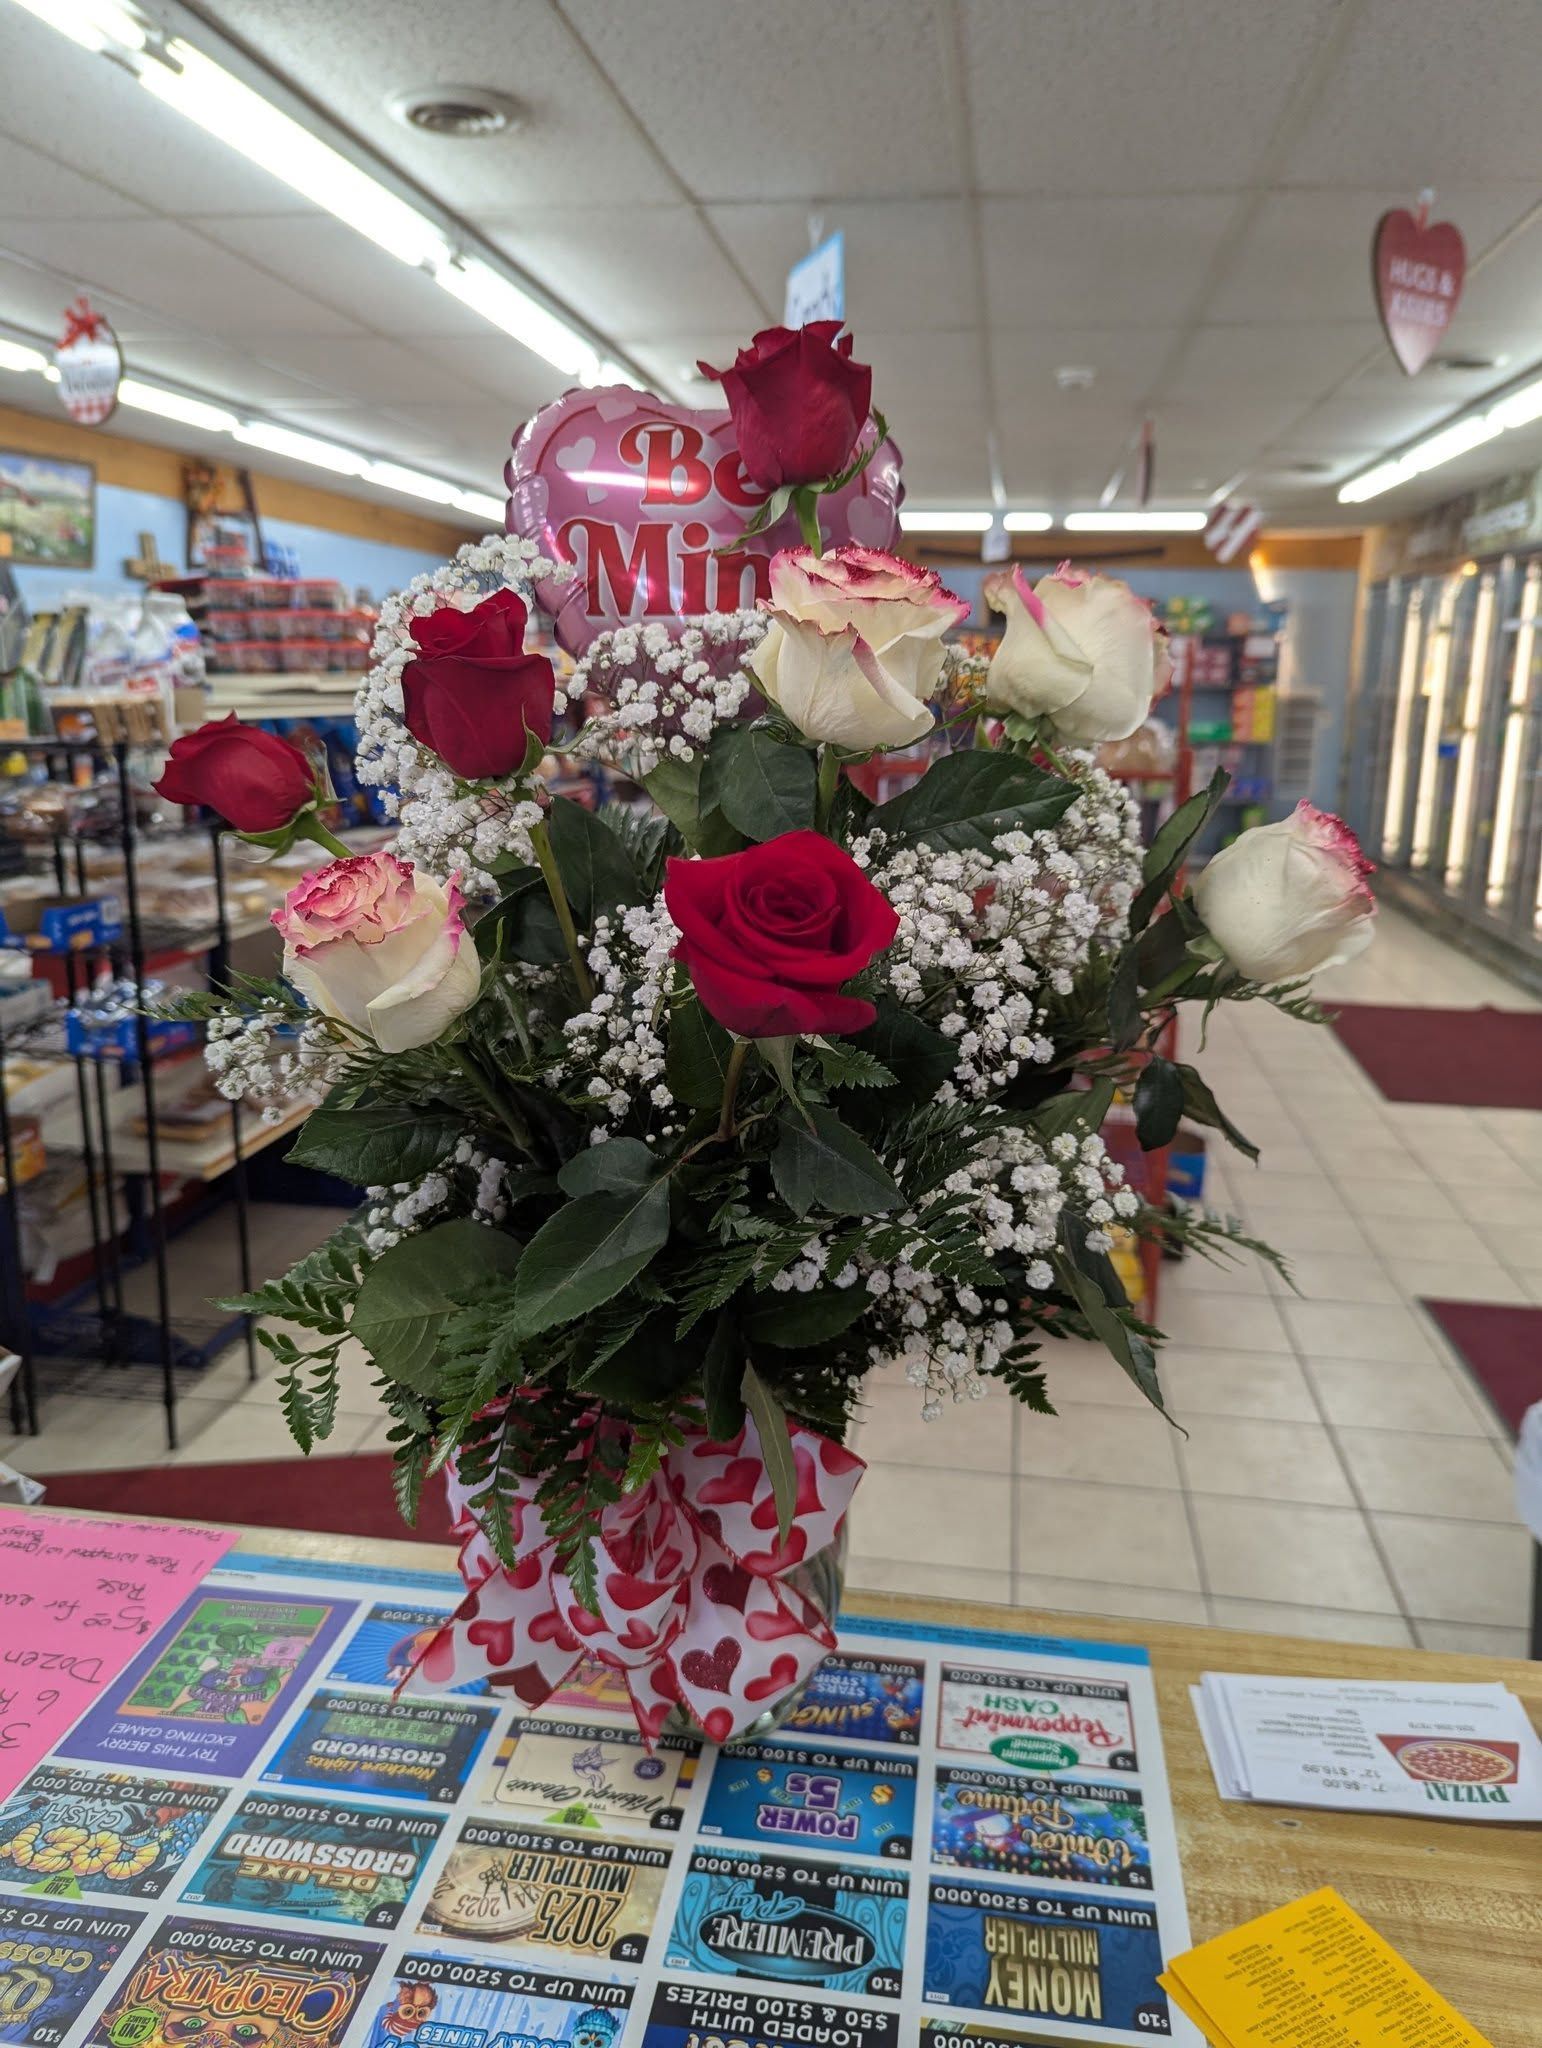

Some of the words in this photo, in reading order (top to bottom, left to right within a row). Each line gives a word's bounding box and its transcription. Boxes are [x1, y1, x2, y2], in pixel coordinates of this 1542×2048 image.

[618, 420, 771, 510] Be
[556, 517, 771, 618] Min
[46, 1600, 80, 1621] for
[823, 1658, 846, 1668] TO
[852, 1660, 876, 1671] UP
[880, 1663, 915, 1675] WIN
[1024, 1679, 1047, 1690] TO
[1052, 1683, 1078, 1693] UP
[1082, 1684, 1120, 1697] WIN
[327, 1698, 388, 1714] $30,000
[391, 1706, 414, 1717] TO
[983, 1695, 1059, 1715] CASH
[416, 1709, 440, 1720] UP
[444, 1712, 477, 1725] WIN
[107, 1722, 162, 1737] GAME!
[518, 1720, 596, 1736] $100,000
[600, 1729, 624, 1741] TO
[953, 1707, 1123, 1747] Peppermint
[97, 1737, 150, 1752] BERRY
[165, 1728, 237, 1746] EXCITING
[154, 1743, 187, 1756] THIS
[189, 1747, 220, 1761] TRY
[312, 1740, 447, 1766] CROSSWORD
[723, 1743, 807, 1762] $100,000
[812, 1754, 837, 1765] TO
[842, 1756, 868, 1769] UP
[874, 1760, 914, 1775] WIN
[32, 1775, 117, 1797] $100,000
[950, 1769, 1028, 1789] $100,000
[1032, 1780, 1057, 1793] TO
[120, 1786, 142, 1800] TO
[148, 1791, 175, 1804] UP
[440, 1788, 454, 1799] $3
[785, 1772, 840, 1810] 5s
[1061, 1784, 1087, 1795] UP
[1090, 1786, 1128, 1800] WIN
[1424, 1782, 1510, 1803] PIZZA!
[178, 1794, 219, 1808] WIN
[584, 1783, 664, 1813] Vikings
[41, 1803, 121, 1828] CASH
[243, 1800, 331, 1823] $100,000
[956, 1789, 1075, 1830] Fortune
[336, 1813, 360, 1827] TO
[366, 1817, 394, 1832] UP
[660, 1814, 675, 1825] $5
[757, 1805, 858, 1840] POWER
[399, 1820, 438, 1837] WIN
[465, 1827, 554, 1850] $100,000
[220, 1832, 417, 1878] CROSSWORD
[560, 1840, 585, 1854] TO
[592, 1844, 619, 1858] UP
[890, 1842, 905, 1854] $5
[1021, 1828, 1136, 1868] Winter
[623, 1848, 666, 1865] WIN
[236, 1859, 379, 1893] DELUXE
[504, 1852, 634, 1895] MULTIPLIER
[695, 1856, 786, 1880] $200,000
[792, 1869, 820, 1884] TO
[826, 1874, 855, 1889] UP
[1129, 1872, 1146, 1883] $5
[44, 1883, 69, 1896] 2ND
[141, 1880, 159, 1893] $5
[862, 1878, 903, 1894] WIN
[718, 1880, 805, 1921] Play
[934, 1887, 1030, 1910] $200,000
[1036, 1901, 1065, 1914] TO
[1071, 1905, 1100, 1919] UP
[21, 1913, 46, 1927] TO
[376, 1910, 393, 1923] $5
[528, 1889, 622, 1950] 2025
[1108, 1909, 1151, 1926] WIN
[53, 1917, 83, 1934] UP
[86, 1920, 130, 1937] WIN
[169, 1930, 257, 1953] $200,000
[707, 1915, 865, 1965] PREMIERE
[984, 1916, 1099, 1965] MULTIPLIER
[259, 1943, 285, 1957] TO
[289, 1947, 318, 1962] UP
[621, 1943, 639, 1957] $5
[320, 1951, 363, 1968] WIN
[404, 1959, 503, 1986] $200,000
[509, 1974, 538, 1990] TO
[545, 1980, 575, 1996] UP
[871, 1977, 900, 1991] $10
[984, 1959, 1102, 2019] MONEY
[137, 1956, 350, 2029] CLEOPATRA
[581, 1984, 627, 2004] WIN
[665, 1985, 748, 2010] PRIZES
[755, 1998, 813, 2020] $100
[821, 2007, 837, 2023] &
[690, 2009, 754, 2033] WITH
[844, 2011, 888, 2031] $50
[1138, 2012, 1168, 2028] $10
[32, 2028, 62, 2043] $10
[119, 2023, 146, 2040] 2ND
[415, 2023, 486, 2047] LINES
[762, 2020, 863, 2048] LOADED
